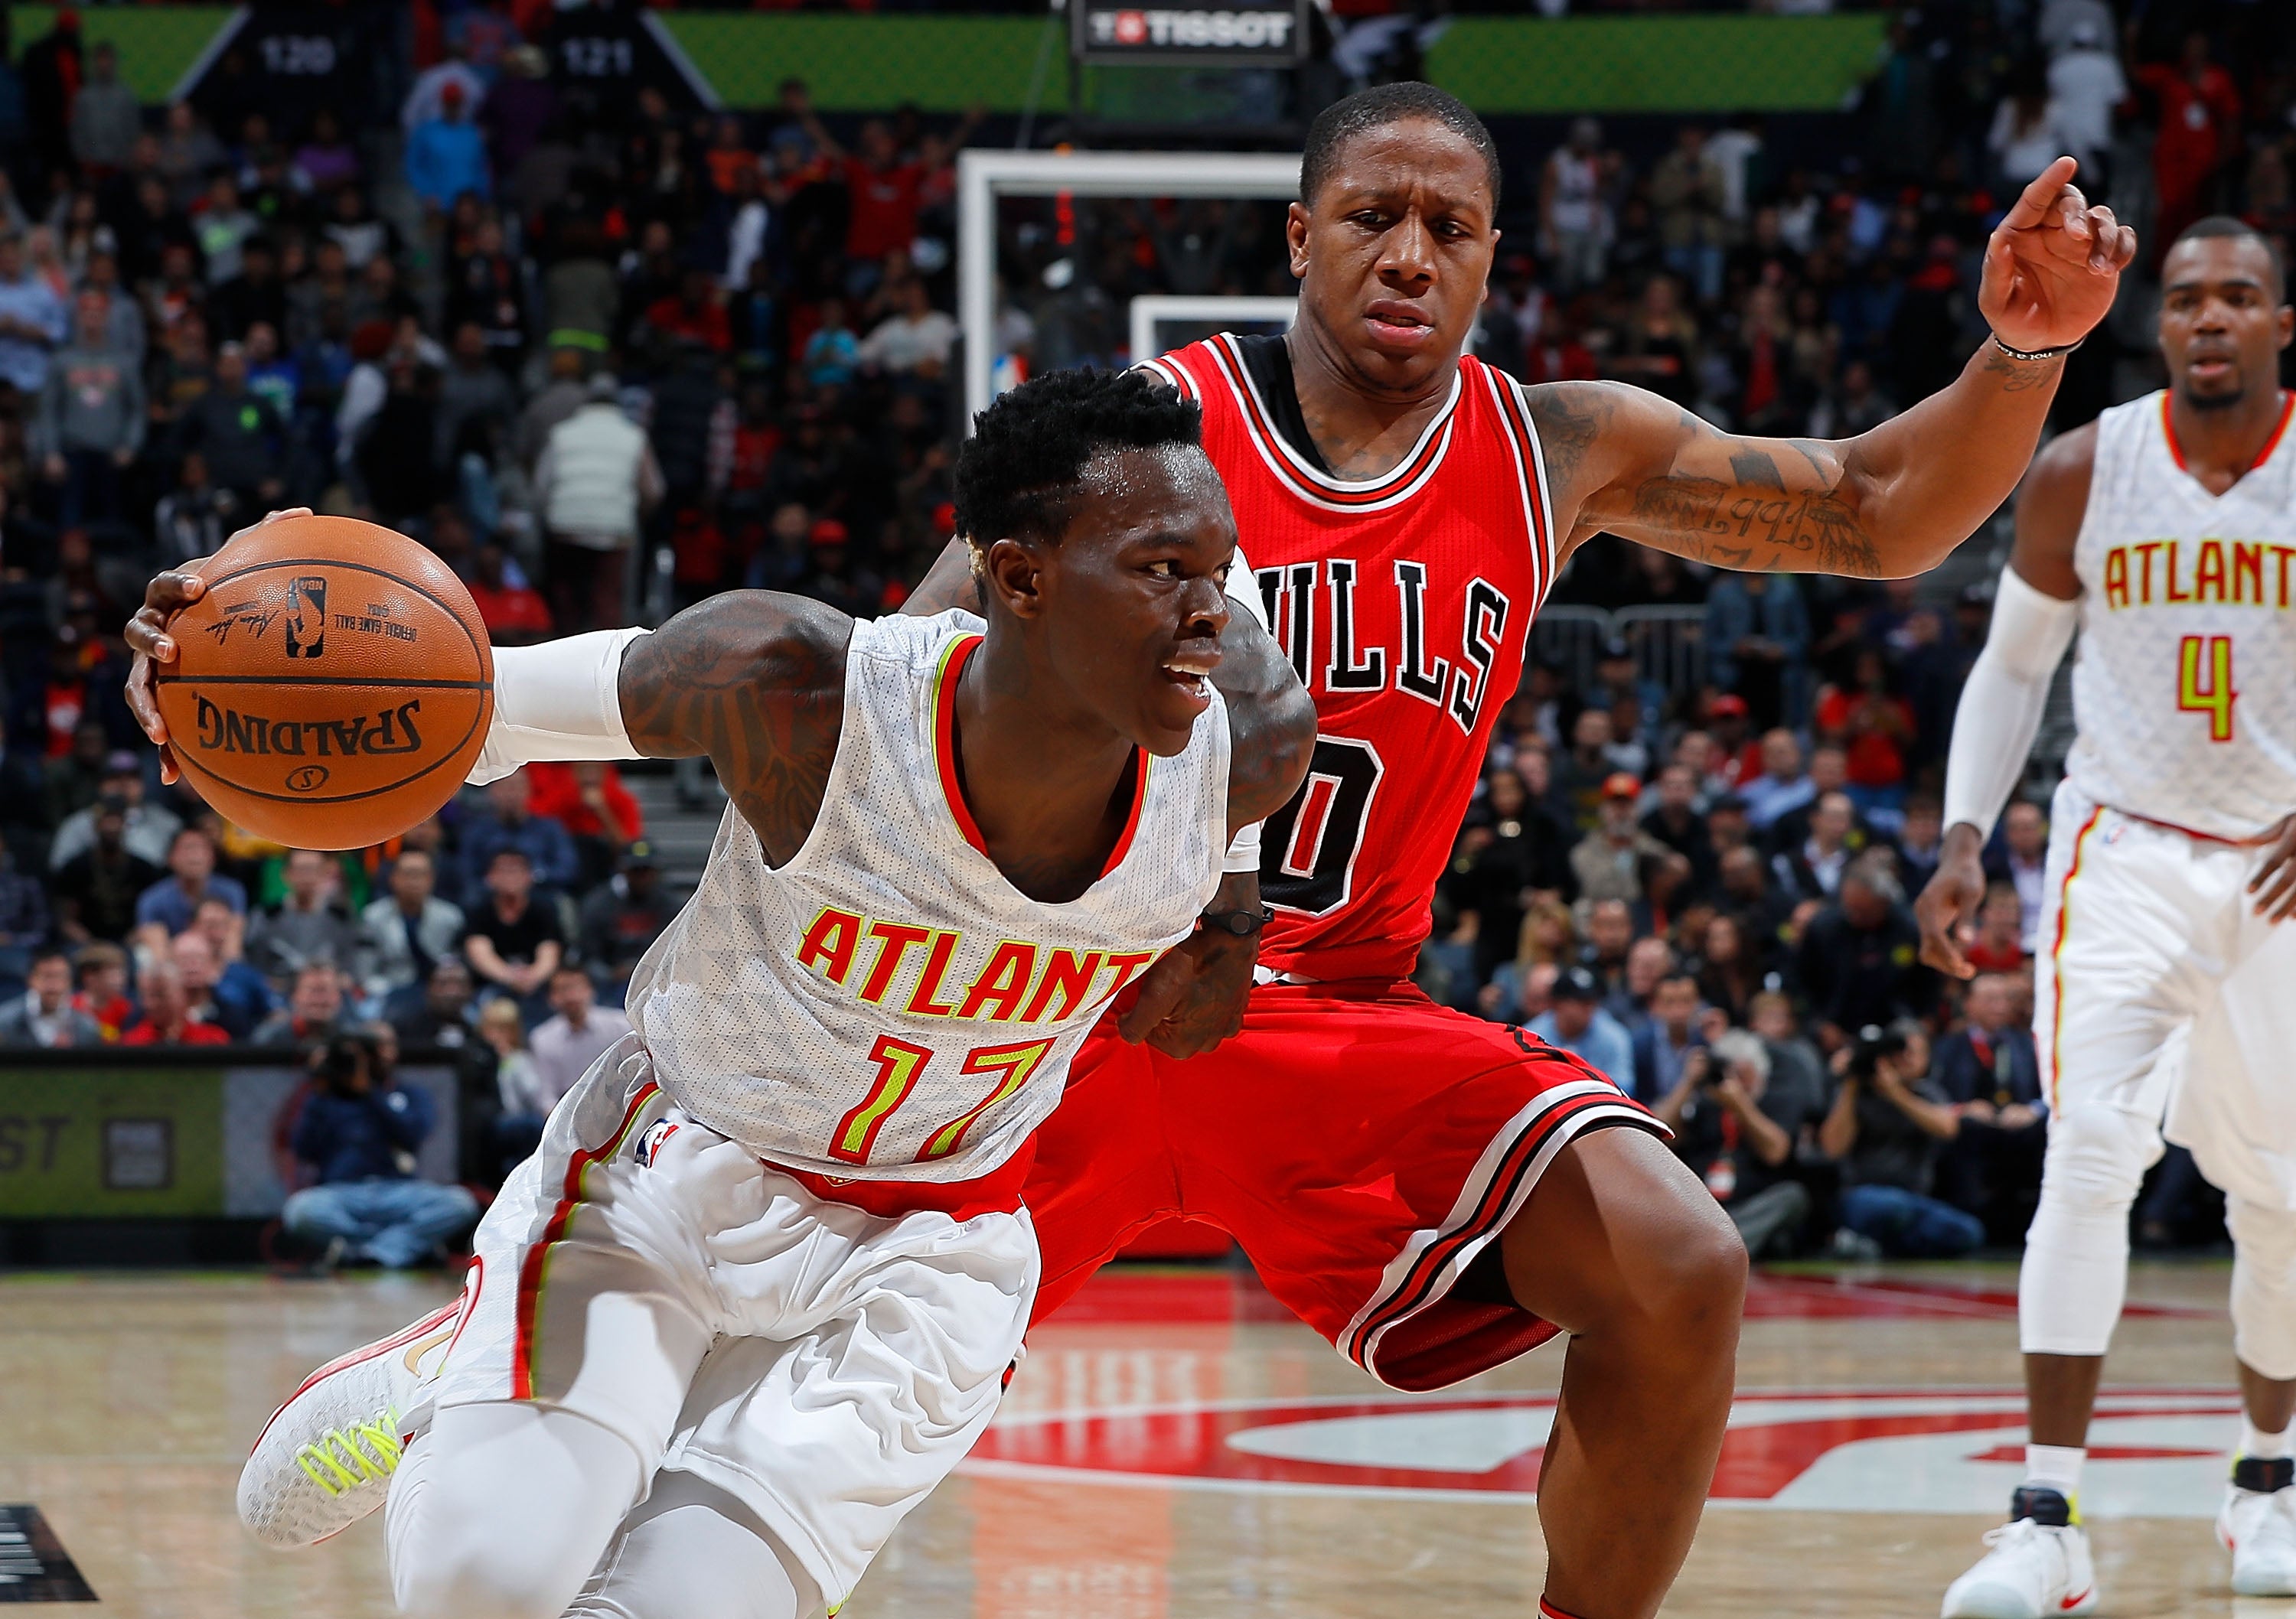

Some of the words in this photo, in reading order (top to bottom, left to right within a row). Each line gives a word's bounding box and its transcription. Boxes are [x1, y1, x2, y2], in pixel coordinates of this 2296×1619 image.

[1146, 11, 1294, 47] TISSOT
[260, 35, 335, 75] 120
[562, 37, 632, 75] 121
[2106, 540, 2296, 609] ATLANT
[334, 614, 356, 630] BALL
[358, 617, 381, 634] GAME
[384, 621, 416, 642] OFFICIAL
[1254, 559, 1509, 737] ULLS
[2177, 634, 2239, 743] 4
[197, 695, 422, 756] SPALDING
[794, 905, 1174, 1024] ATLANT
[827, 1034, 1056, 1165] 17
